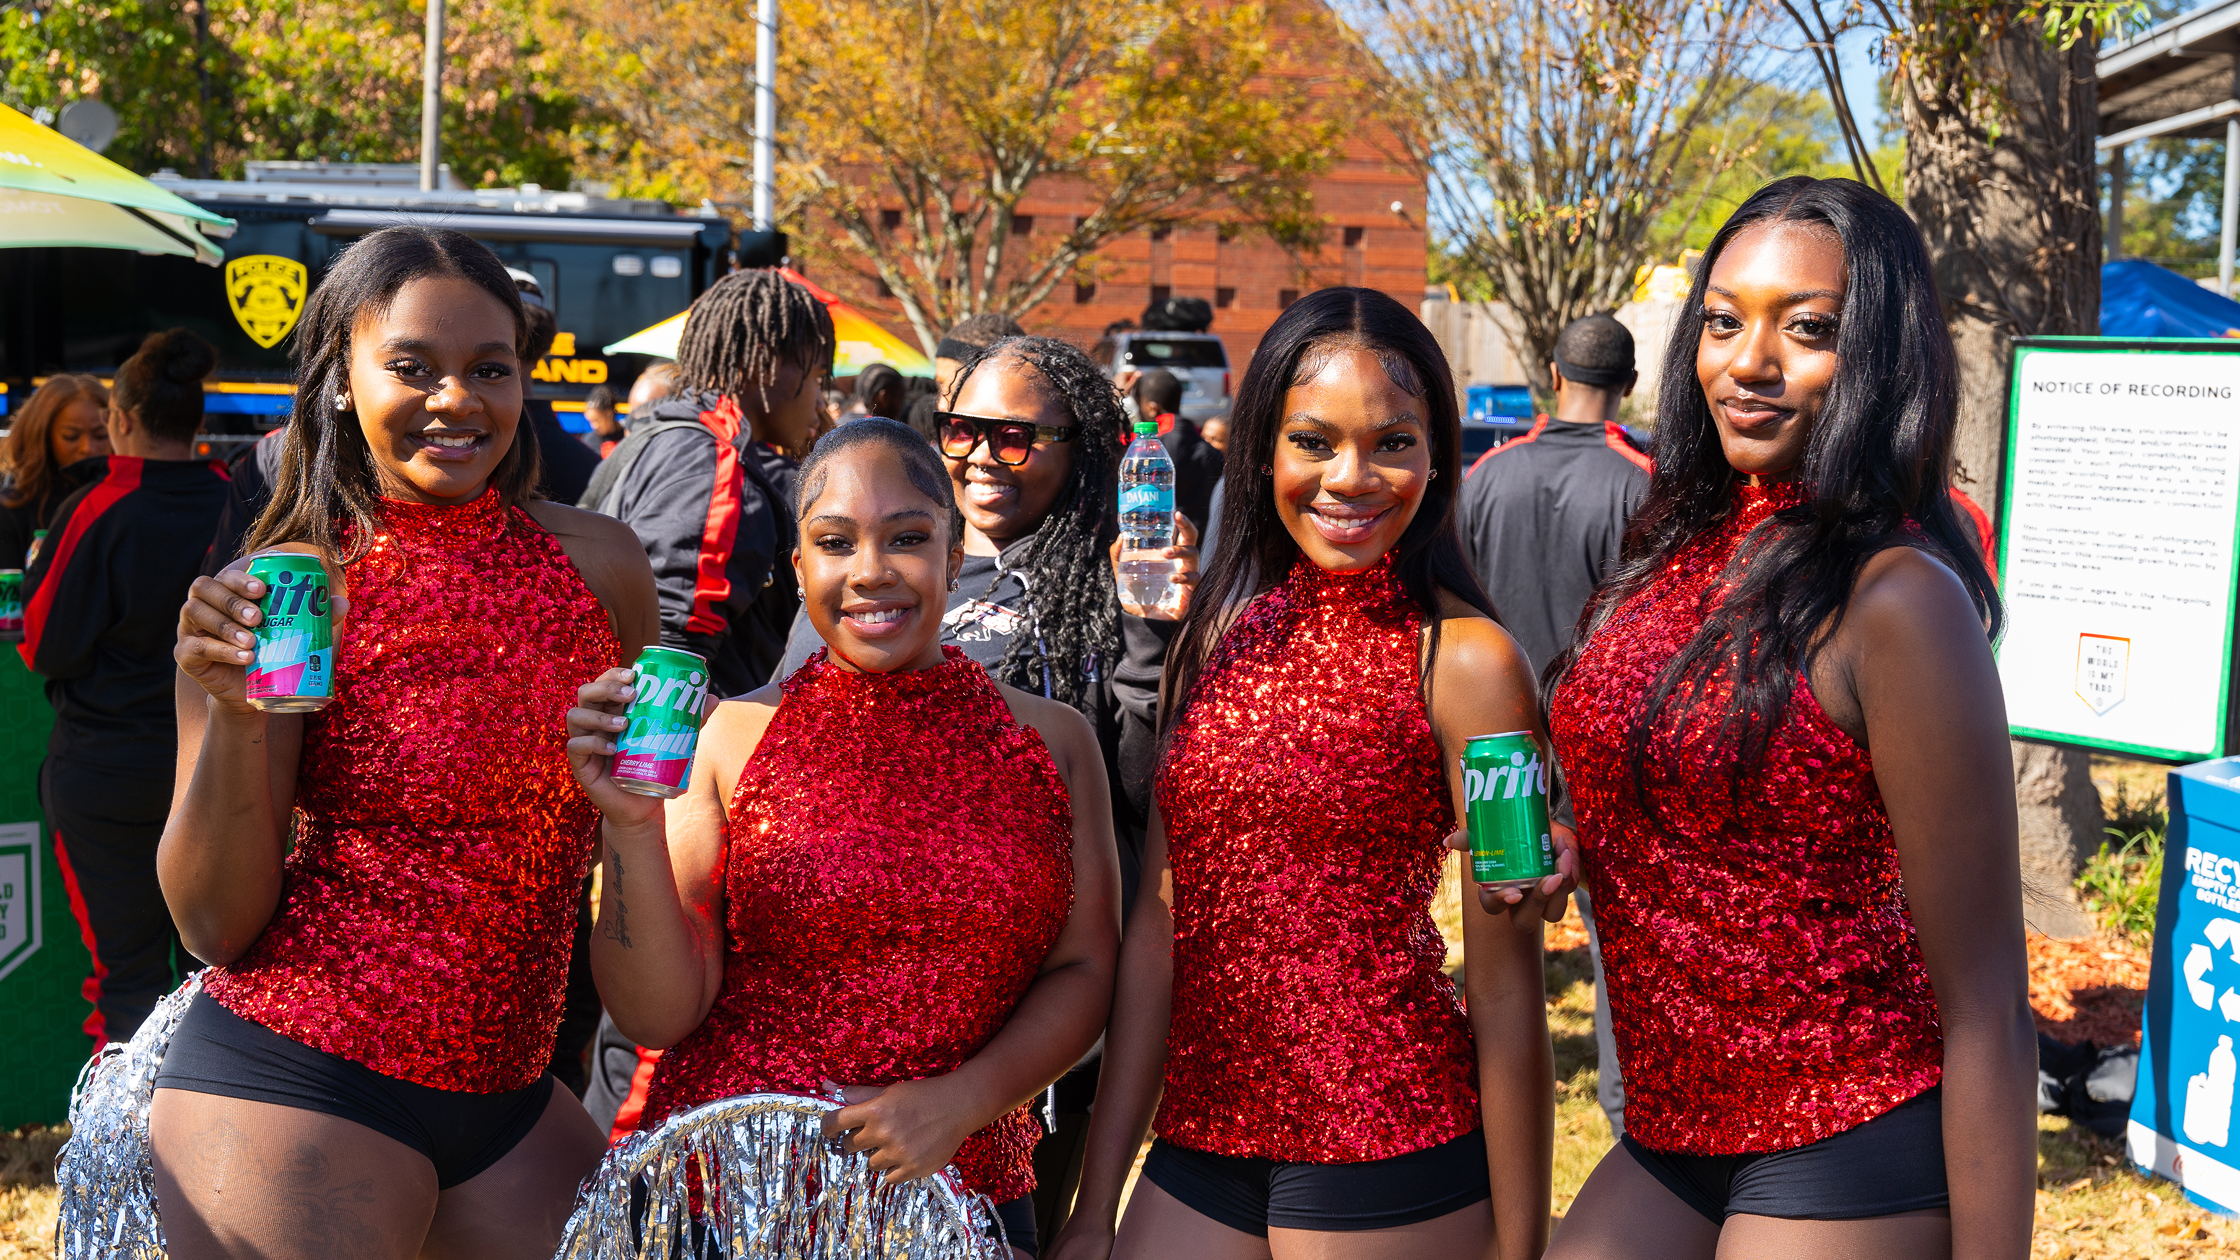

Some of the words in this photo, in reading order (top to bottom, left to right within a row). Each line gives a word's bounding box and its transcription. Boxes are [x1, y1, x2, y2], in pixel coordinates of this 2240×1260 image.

[234, 261, 299, 277] POLICE
[2032, 381, 2094, 395] NOTICE
[2099, 383, 2122, 395] OF
[2128, 383, 2232, 400] RECORDING
[1126, 488, 1159, 506] DASANI
[258, 570, 329, 617] rite
[626, 664, 708, 719] prit
[626, 716, 695, 755] Chill
[620, 759, 640, 767] CHERRY
[639, 761, 655, 770] LIME
